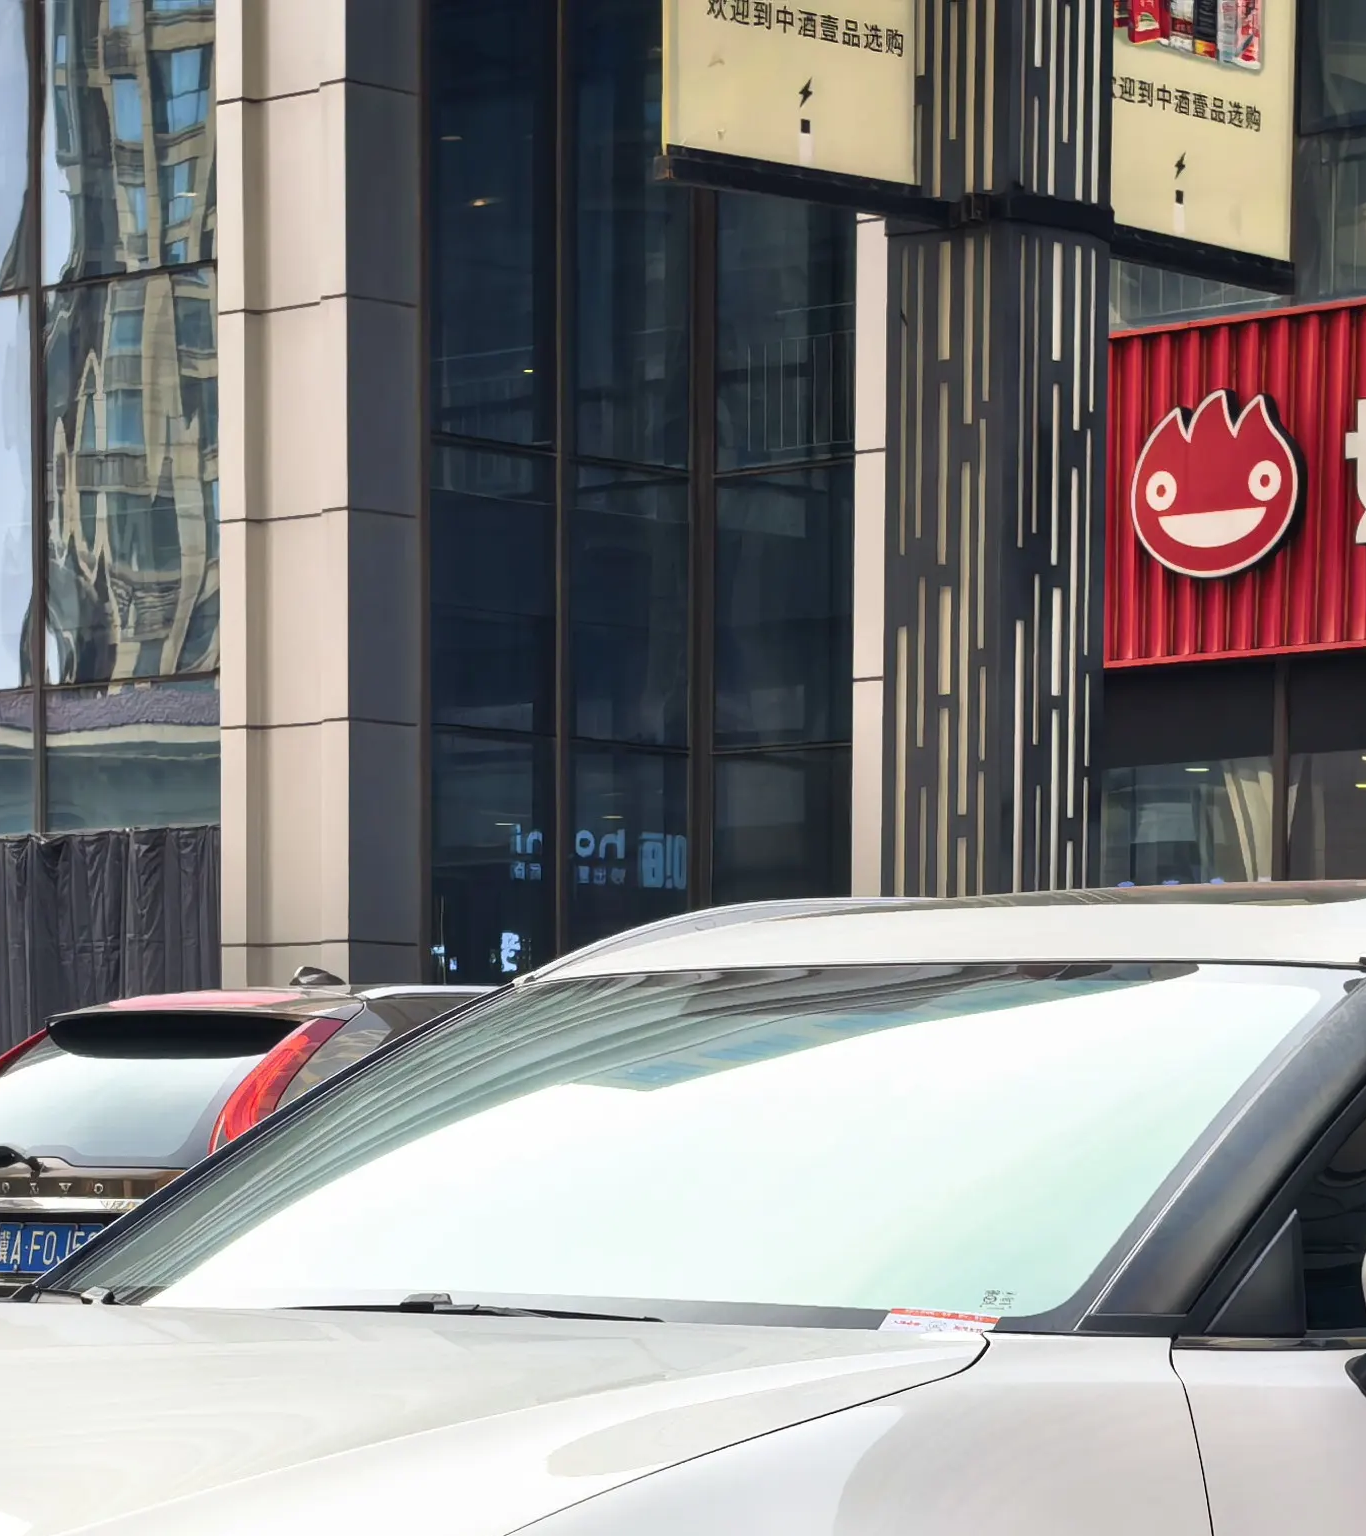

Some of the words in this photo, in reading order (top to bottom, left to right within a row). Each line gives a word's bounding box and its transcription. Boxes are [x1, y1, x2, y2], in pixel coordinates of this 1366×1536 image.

[707, 0, 904, 57] 欢迎到中酒壹品选购
